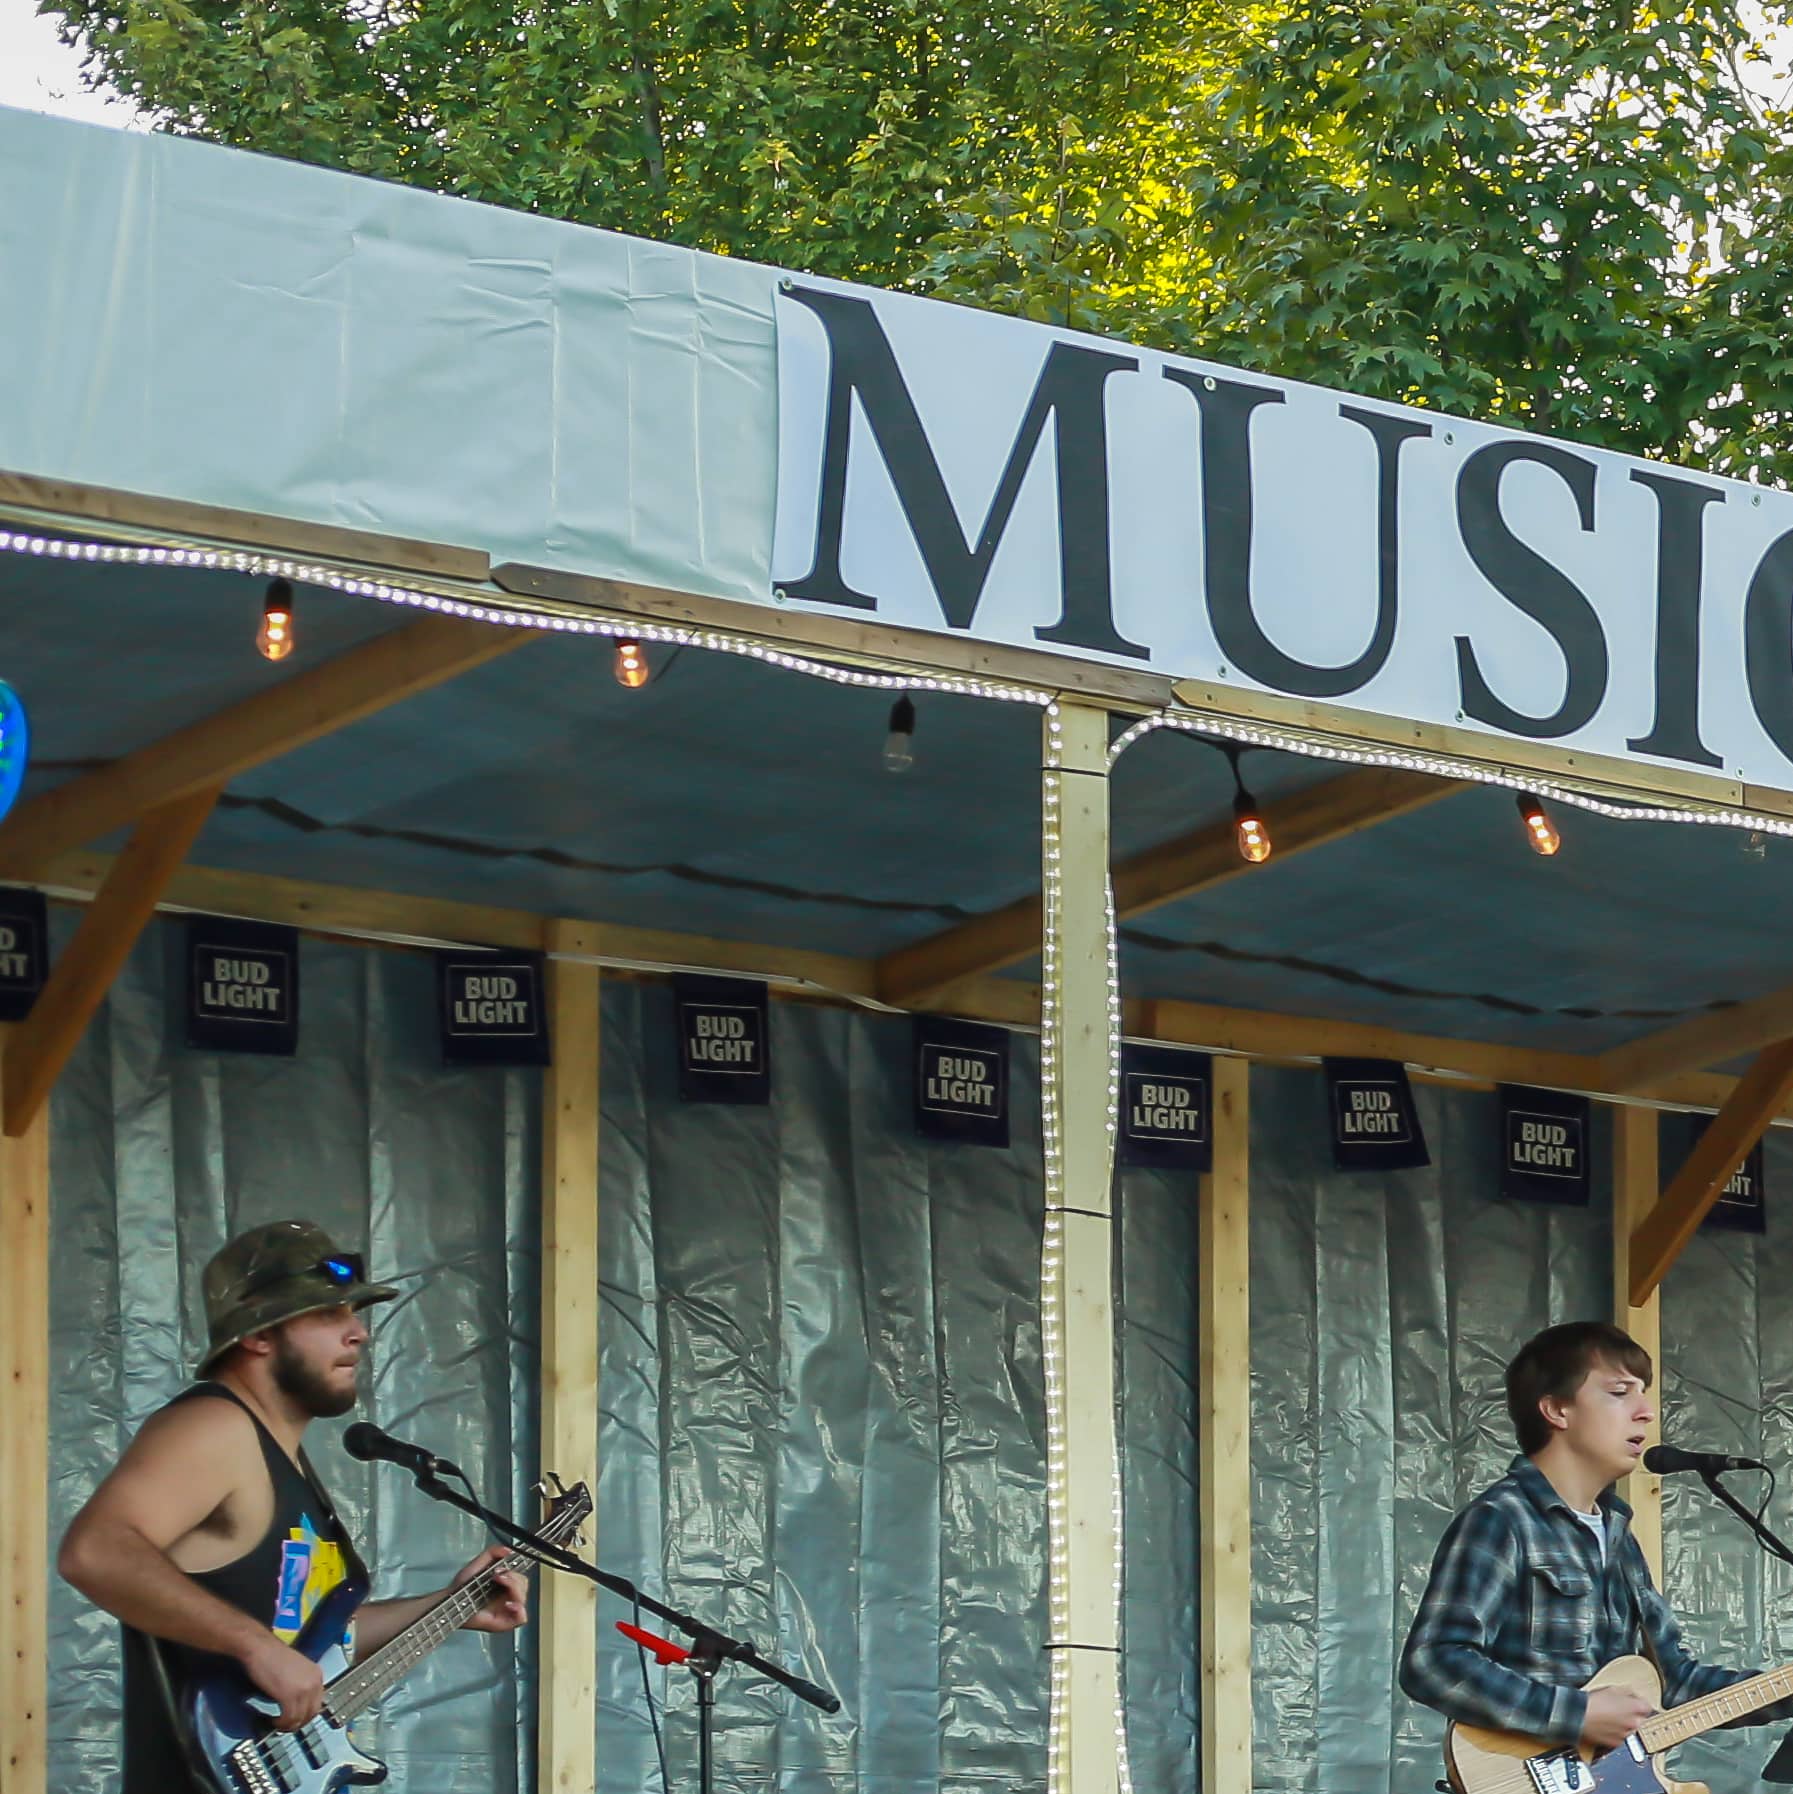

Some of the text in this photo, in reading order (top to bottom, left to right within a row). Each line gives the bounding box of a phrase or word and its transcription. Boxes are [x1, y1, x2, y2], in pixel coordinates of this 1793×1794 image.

[214, 957, 270, 984] BUD
[204, 981, 281, 1011] LIGHT
[465, 976, 517, 1001] BUD
[455, 998, 528, 1025] LIGHT
[696, 1013, 745, 1039] BUD
[690, 1037, 755, 1064] LIGHT
[937, 1056, 987, 1083] BUD
[927, 1077, 994, 1106] LIGHT
[1141, 1084, 1189, 1109] BUD
[1351, 1090, 1391, 1113] BUD
[1133, 1105, 1200, 1132] LIGHT
[1344, 1110, 1400, 1134] LIGHT
[1522, 1123, 1567, 1148] BUD
[1514, 1142, 1575, 1169] LIGHT
